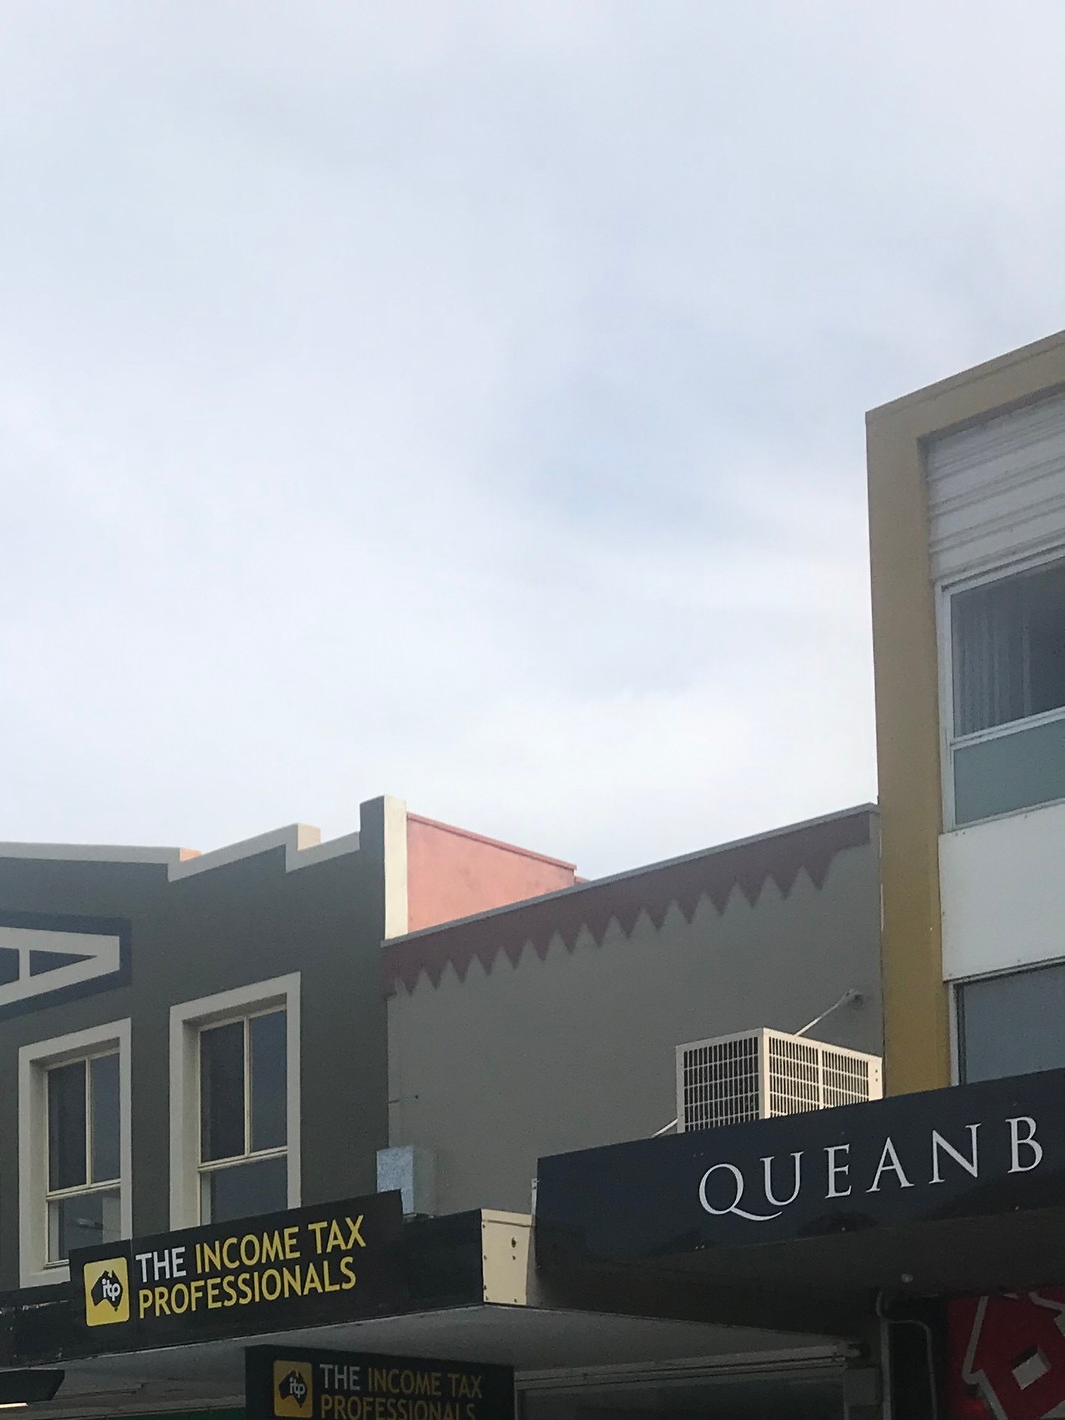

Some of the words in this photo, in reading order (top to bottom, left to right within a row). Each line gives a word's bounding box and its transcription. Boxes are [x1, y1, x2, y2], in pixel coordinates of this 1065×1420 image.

[698, 1115, 1044, 1222] QUEANB
[135, 1246, 187, 1283] THE
[195, 1225, 301, 1274] INCOME
[307, 1214, 367, 1255] TAX
[101, 1278, 121, 1302] itp
[138, 1256, 357, 1320] PROFESSIONALS
[289, 1376, 306, 1398] itp
[319, 1363, 361, 1391] THE
[367, 1367, 442, 1397] INCOME
[447, 1371, 484, 1399] TAX
